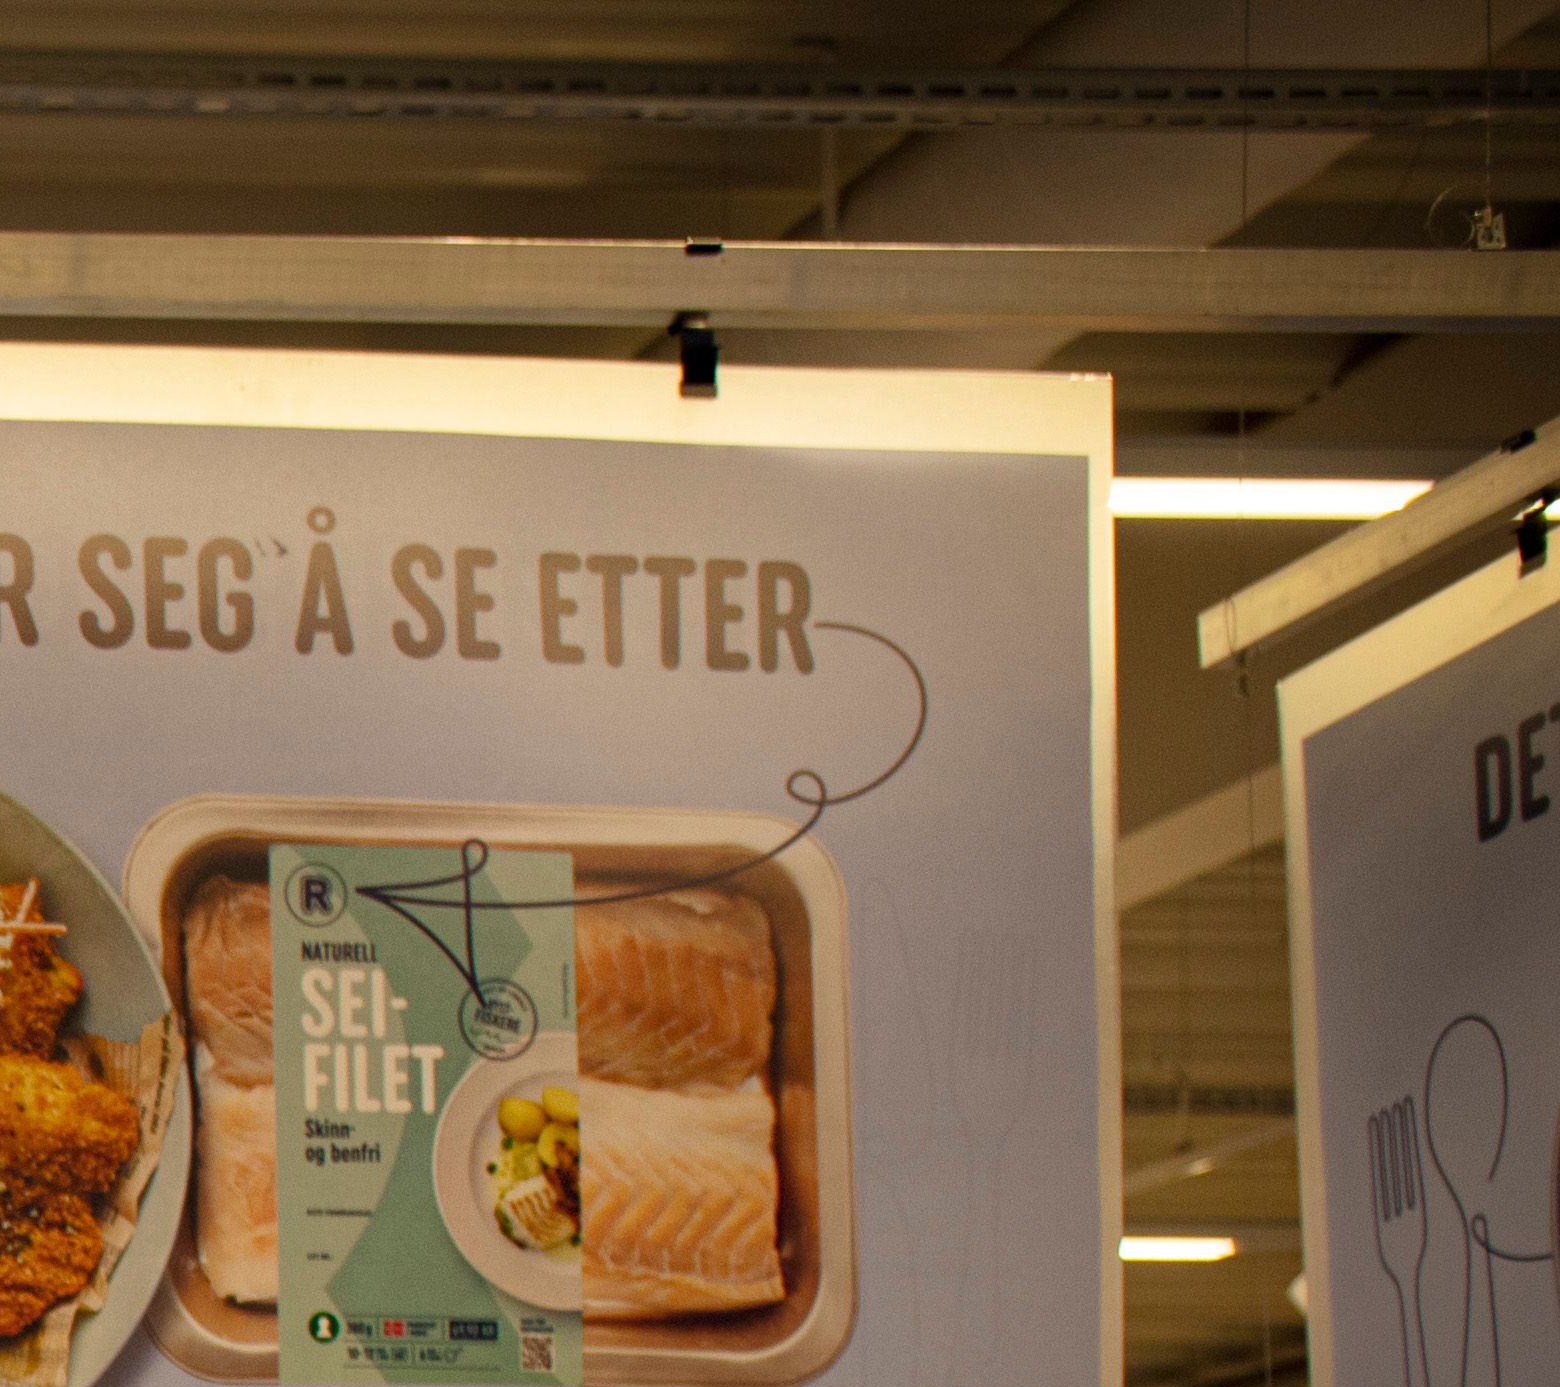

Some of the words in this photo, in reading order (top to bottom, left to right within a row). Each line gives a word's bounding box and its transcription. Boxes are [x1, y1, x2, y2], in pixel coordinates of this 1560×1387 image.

[79, 535, 254, 653] SEG
[295, 507, 354, 657] Å
[392, 544, 501, 661] SE
[539, 552, 818, 675] ETTER
[1474, 703, 1560, 842] DE
[301, 942, 377, 963] NATURELL
[301, 967, 409, 1039] SEI-
[304, 1043, 445, 1115] FILET
